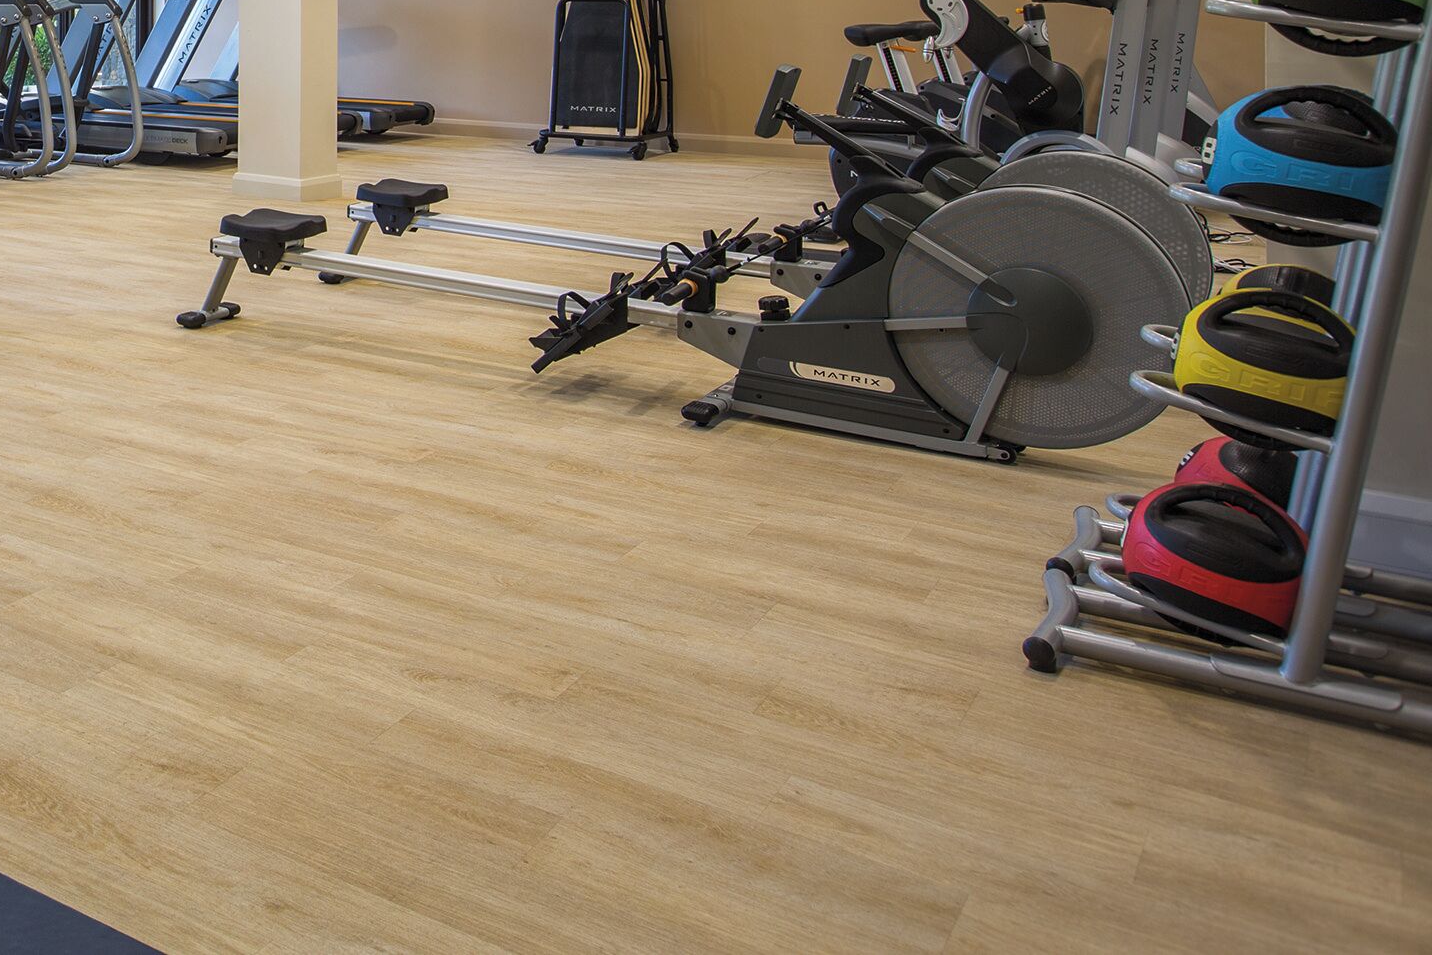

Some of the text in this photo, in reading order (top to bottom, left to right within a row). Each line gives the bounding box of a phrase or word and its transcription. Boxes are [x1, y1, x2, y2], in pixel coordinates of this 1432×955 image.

[178, 3, 212, 64] MATRIX
[1170, 32, 1185, 93] MATRIX
[1109, 43, 1128, 115] MATRIX
[1143, 38, 1159, 104] MATRIX
[570, 105, 617, 113] MATRIX
[1202, 136, 1217, 165] 8
[813, 368, 881, 388] MATRIX
